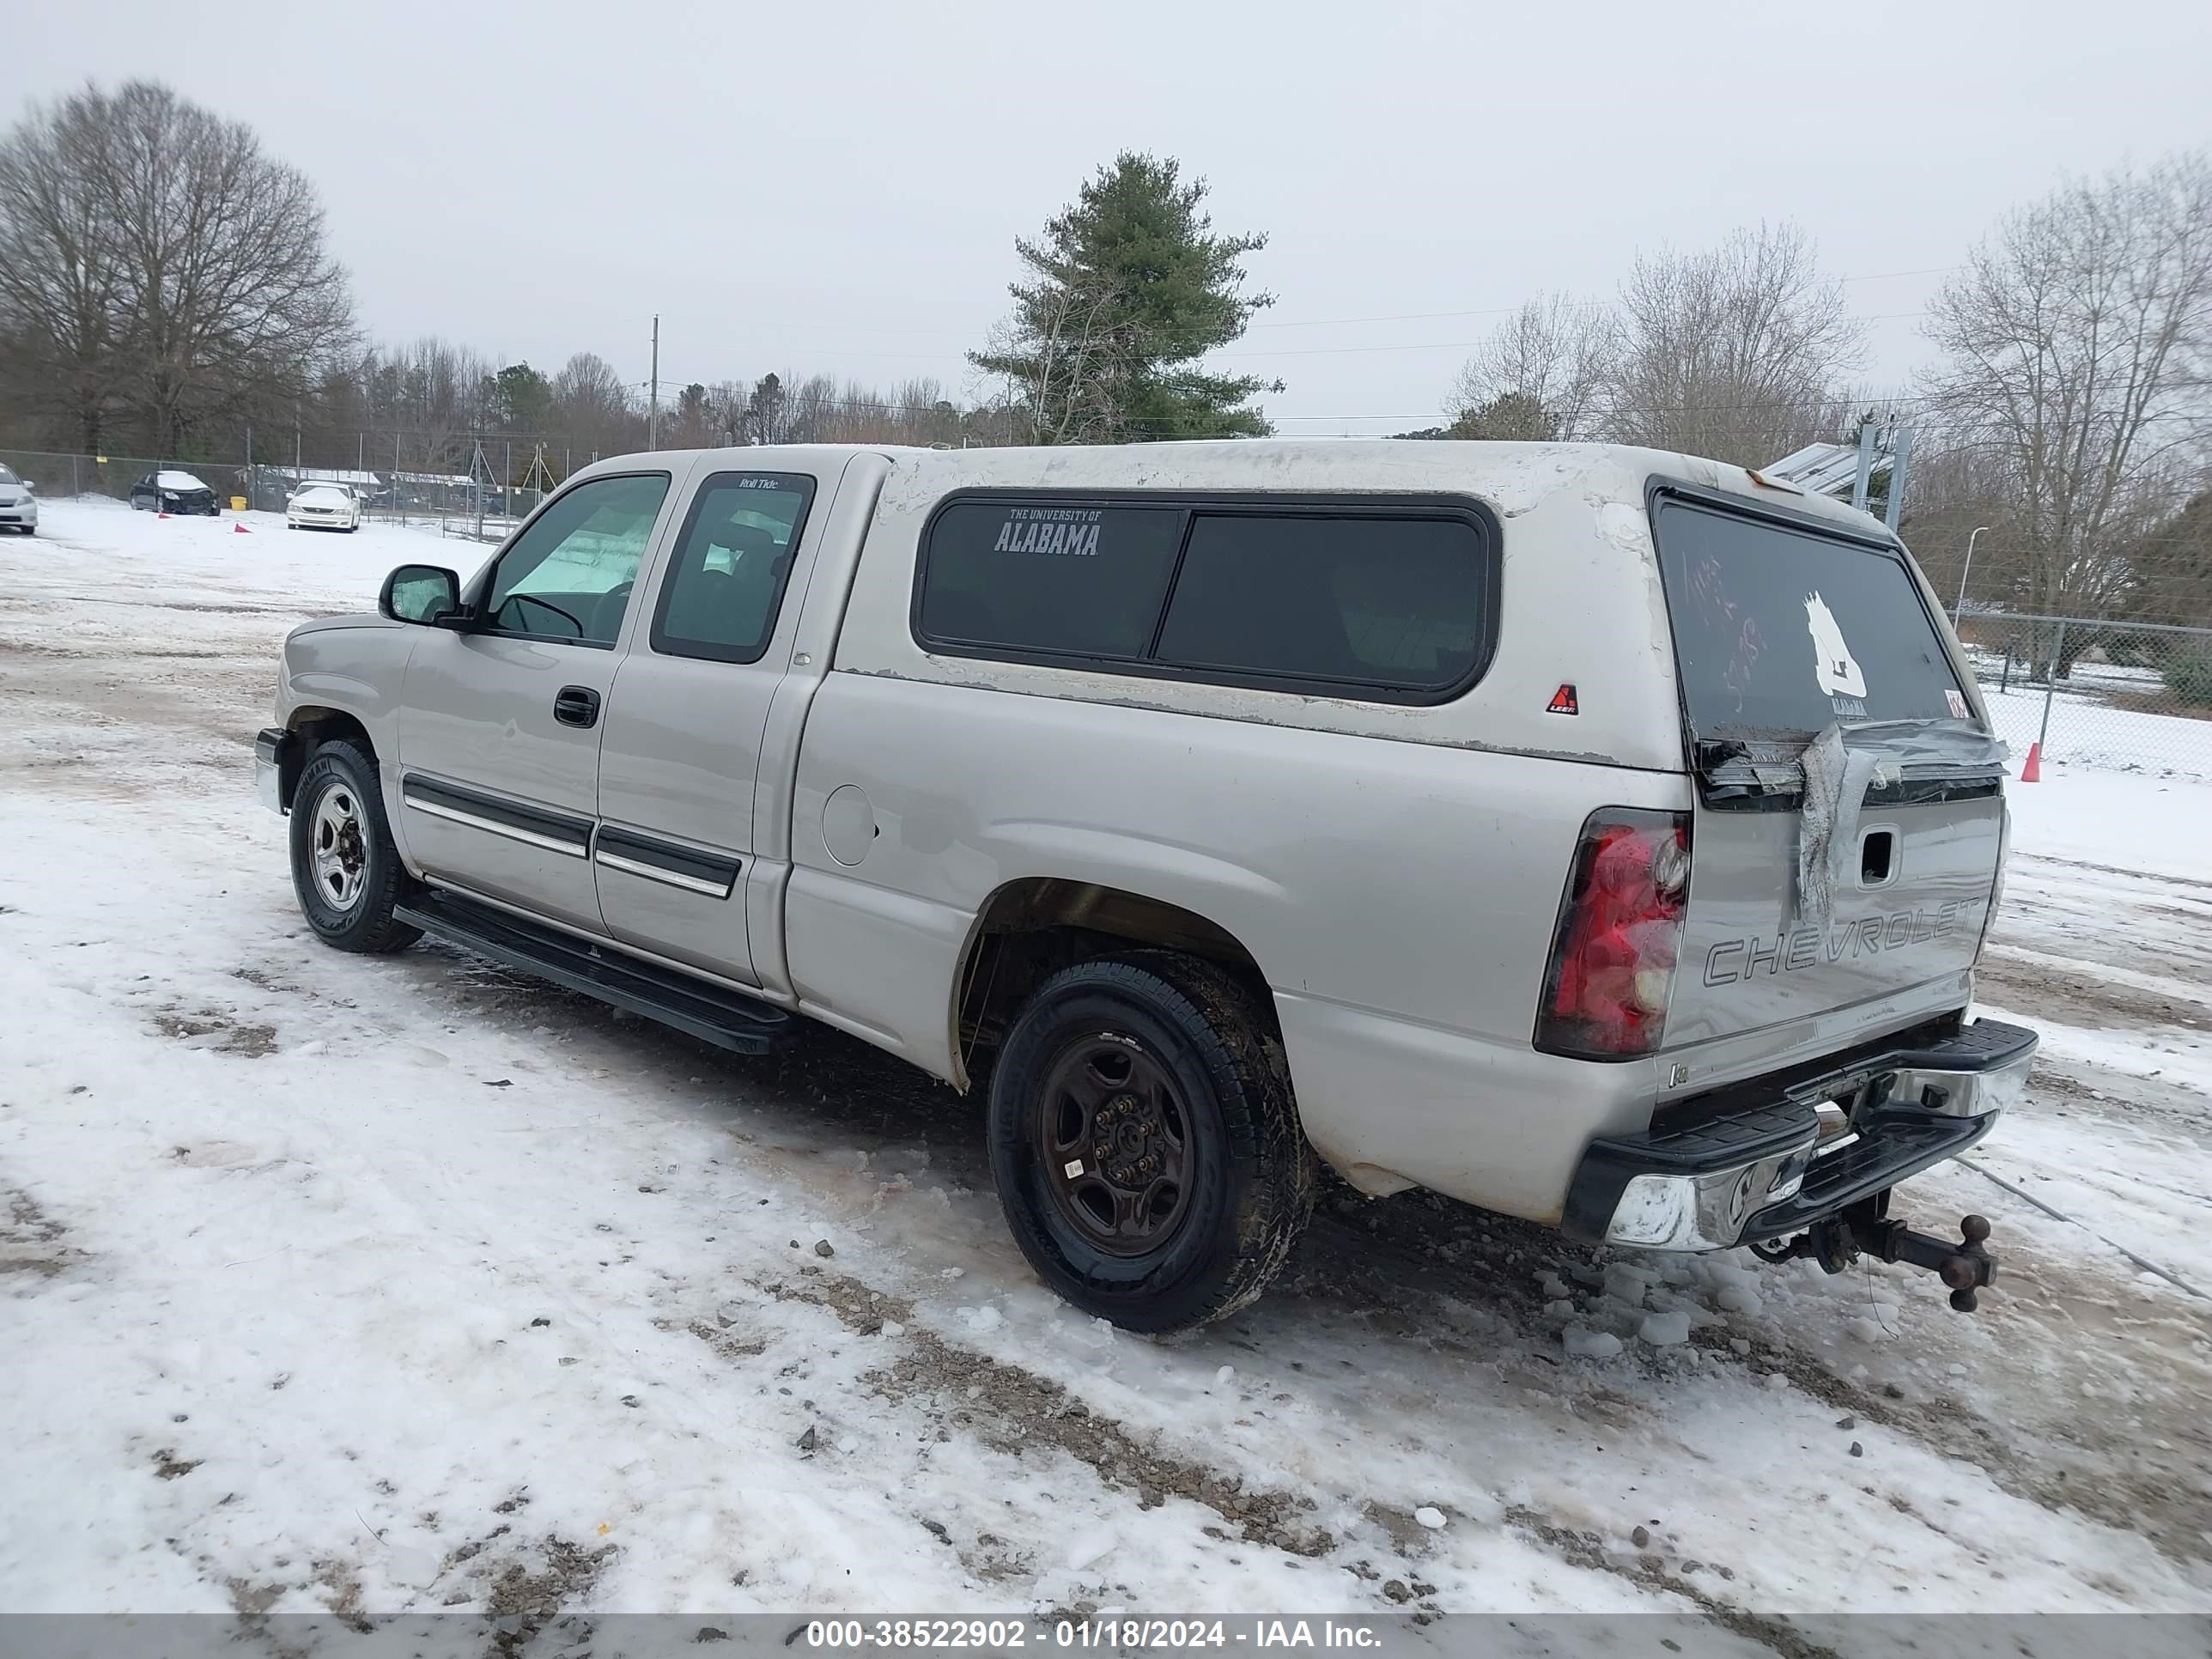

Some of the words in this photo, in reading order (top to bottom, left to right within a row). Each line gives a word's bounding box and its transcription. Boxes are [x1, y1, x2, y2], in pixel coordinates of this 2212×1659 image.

[757, 479, 778, 489] Tide
[1010, 508, 1029, 520] THE
[1029, 509, 1089, 521] UNIVERSITY
[1088, 511, 1102, 521] OF
[994, 521, 1101, 556] ALABAMA
[1549, 705, 1576, 714] LEER
[1703, 896, 1979, 988] CHEVROLET
